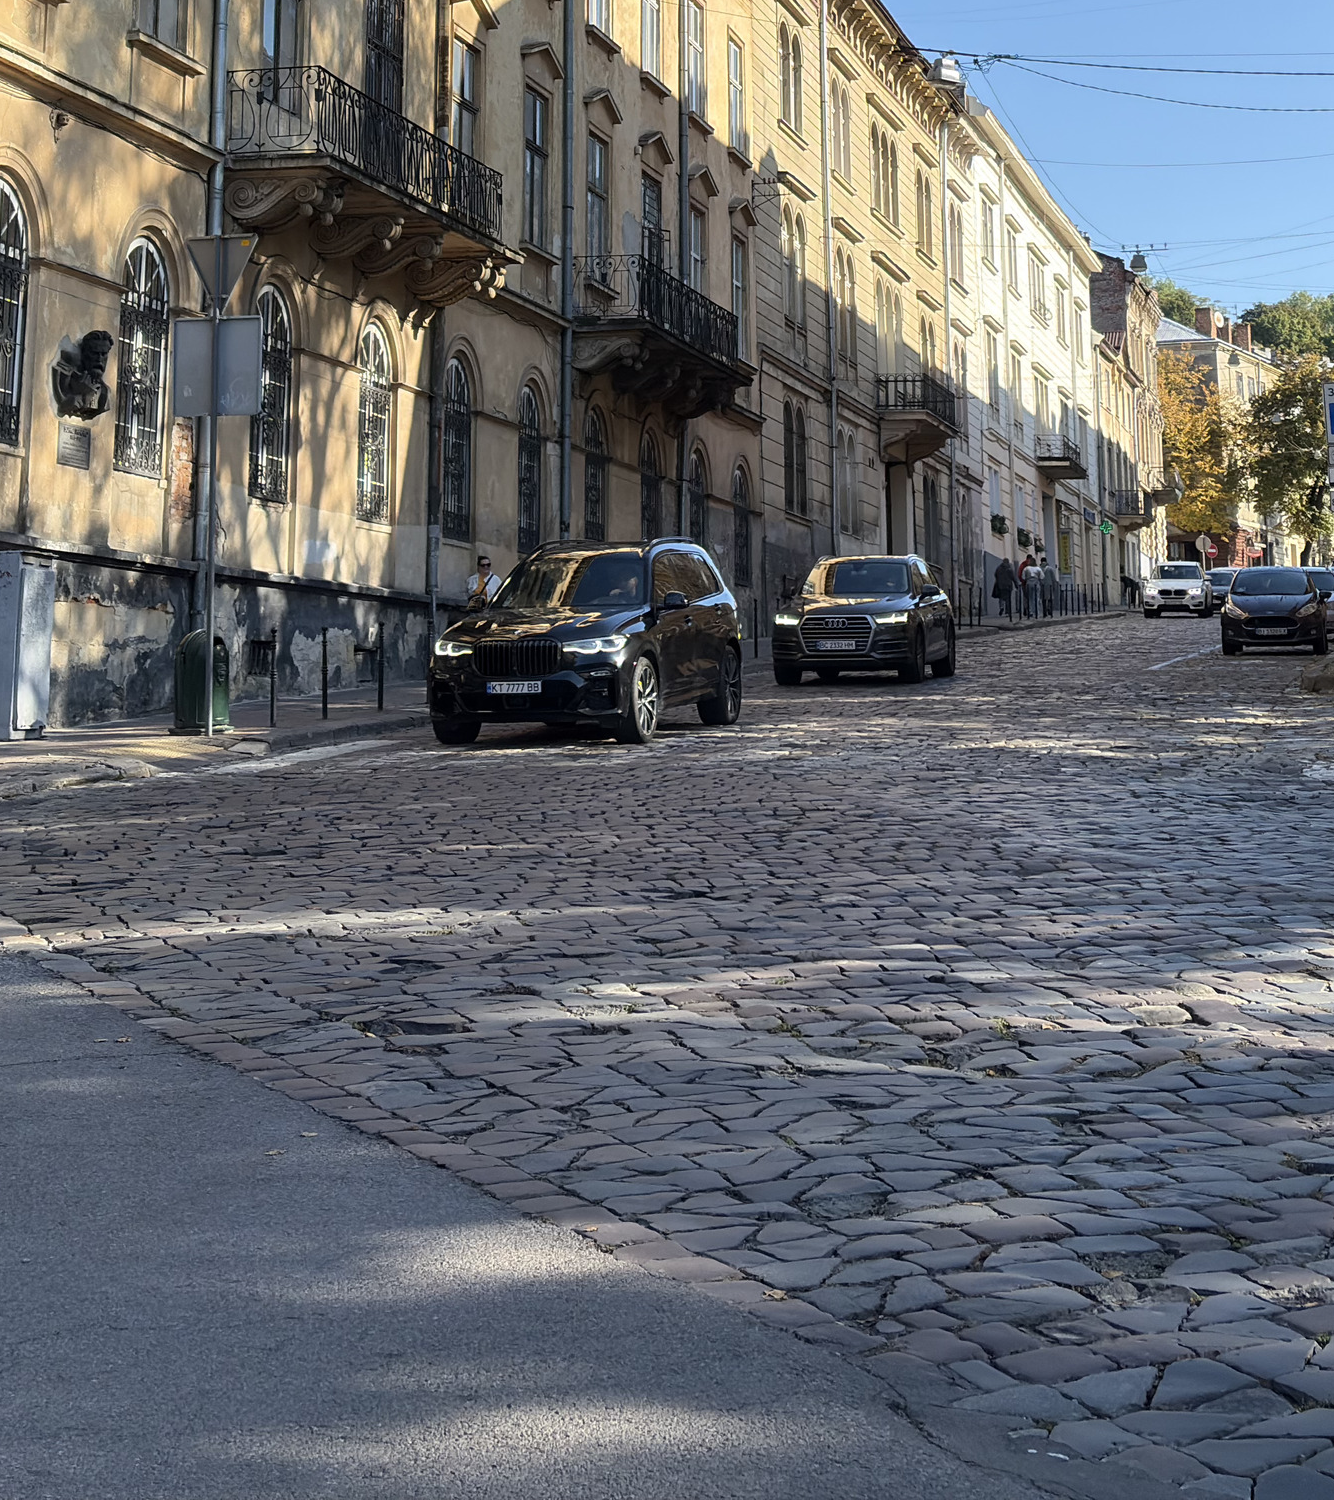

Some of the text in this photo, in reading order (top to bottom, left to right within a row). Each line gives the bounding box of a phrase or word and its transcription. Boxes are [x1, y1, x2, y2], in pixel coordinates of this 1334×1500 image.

[492, 682, 539, 692] KT 7777 BB
